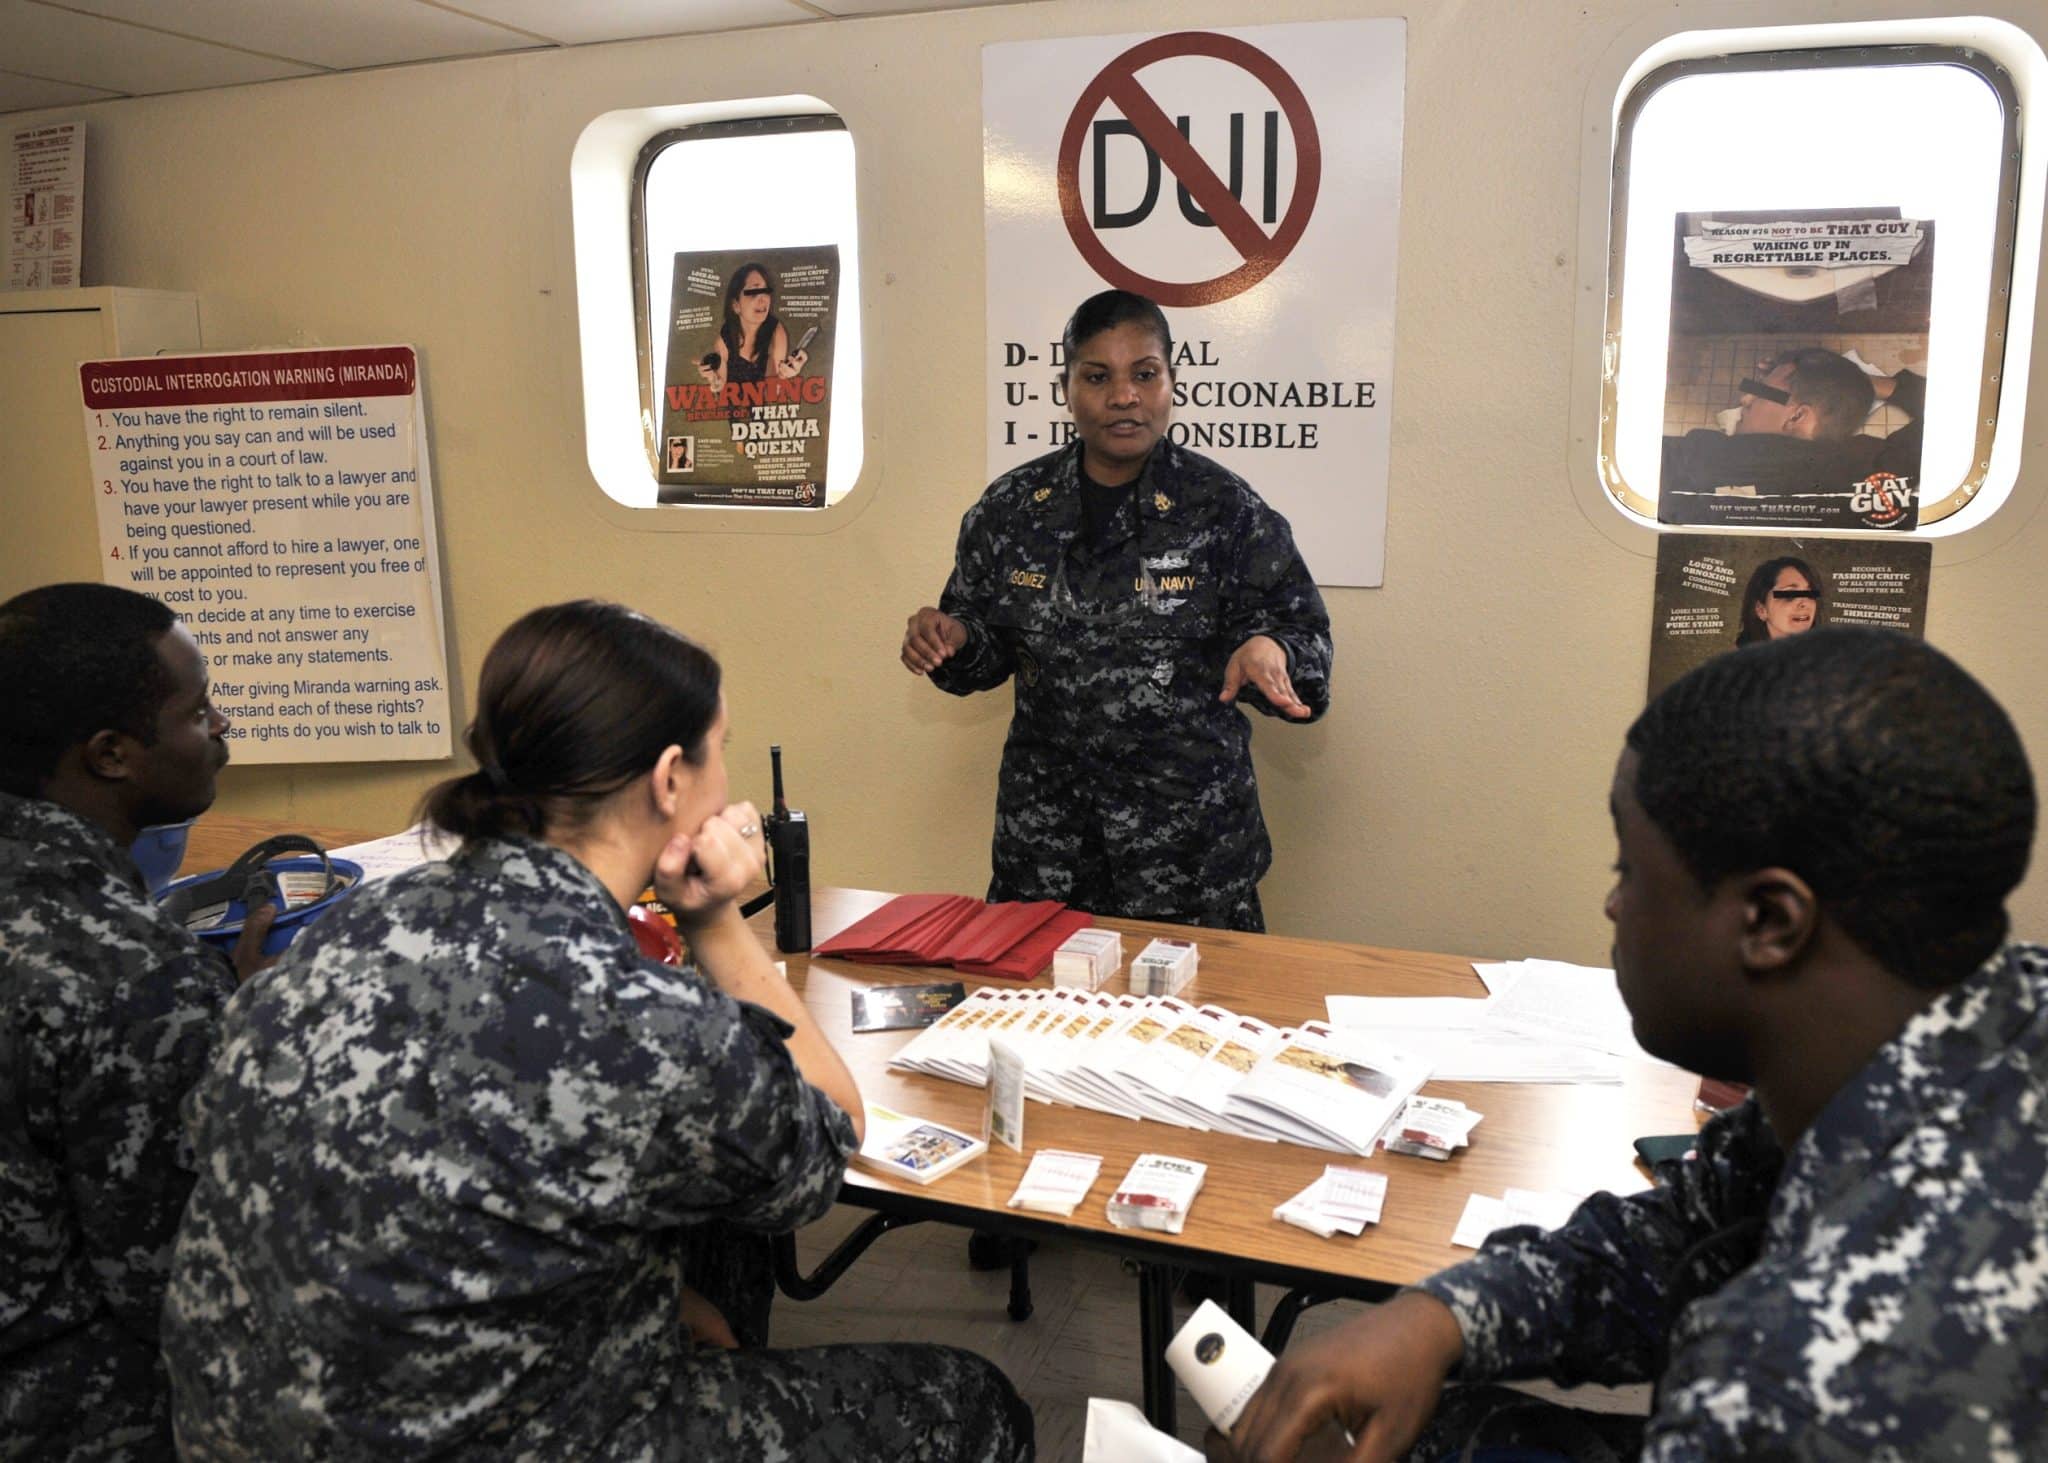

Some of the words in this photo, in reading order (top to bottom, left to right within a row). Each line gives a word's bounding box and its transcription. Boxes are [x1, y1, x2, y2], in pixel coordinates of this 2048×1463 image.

[1093, 110, 1279, 229] DUI
[1711, 228, 1750, 236] REASON
[1771, 227, 1792, 235] NOT
[1826, 225, 1872, 235] THAT
[1875, 222, 1909, 234] GUY
[1752, 241, 1809, 250] WAKING
[1813, 241, 1831, 250] UP
[1835, 240, 1851, 249] IN
[1713, 252, 1824, 263] REGRETTABLE
[1828, 250, 1891, 261] PLACES.
[91, 376, 163, 394] CUSTODIAL
[166, 370, 271, 391] INTERROGATION
[273, 367, 335, 385] WARNING
[339, 363, 408, 386] (MIRANDA)
[666, 376, 825, 411] WARNING
[1050, 381, 1376, 408] USCIONABLE
[96, 414, 109, 428] 1.
[112, 412, 141, 427] You
[145, 411, 181, 426] have
[185, 409, 209, 423] the
[213, 408, 246, 425] right
[250, 407, 264, 421] to
[268, 404, 320, 420] remain
[324, 402, 367, 418] silent.
[752, 404, 800, 420] THAT
[97, 435, 112, 450] 2.
[115, 434, 179, 452] Anything
[183, 434, 210, 450] you
[215, 433, 240, 448] say
[245, 431, 272, 444] can
[276, 428, 304, 441] and
[308, 426, 332, 440] will
[336, 425, 355, 439] be
[360, 423, 396, 438] used
[731, 419, 820, 441] DRAMA
[1049, 421, 1318, 449] IRONSIBLE
[744, 440, 805, 459] QUEEN
[120, 455, 173, 475] against
[177, 456, 204, 472] you
[208, 453, 221, 468] in
[225, 455, 235, 467] a
[239, 451, 277, 467] court
[280, 450, 295, 465] of
[299, 449, 328, 464] law.
[103, 479, 117, 495] 3.
[120, 479, 149, 494] You
[153, 478, 189, 492] have
[193, 477, 216, 490] the
[221, 474, 254, 493] right
[258, 475, 271, 488] to
[276, 472, 302, 487] talk
[306, 472, 320, 486] to
[325, 474, 334, 486] a
[338, 470, 387, 487] lawyer
[391, 469, 416, 483] and
[1852, 476, 1910, 495] THAT
[124, 501, 160, 515] have
[163, 501, 196, 517] your
[200, 499, 248, 515] lawyer
[252, 496, 308, 514] present
[311, 493, 350, 508] while
[354, 494, 381, 510] you
[385, 494, 410, 506] are
[1850, 488, 1912, 513] GUY
[126, 523, 167, 540] being
[171, 519, 255, 539] questioned.
[110, 546, 125, 560] 4.
[129, 545, 138, 560] If
[142, 547, 169, 563] you
[173, 544, 223, 558] cannot
[227, 540, 269, 556] afford
[273, 541, 287, 554] to
[291, 539, 319, 553] hire
[323, 541, 333, 553] a
[337, 537, 389, 555] lawyer,
[393, 538, 420, 550] one
[131, 567, 154, 581] will
[158, 566, 177, 580] be
[181, 563, 253, 582] appointed
[257, 563, 271, 577] to
[276, 560, 346, 579] represent
[350, 561, 376, 577] you
[380, 558, 410, 573] free
[1682, 566, 1736, 584] OBNOXIOUS
[1688, 560, 1714, 570] LOUD
[1713, 566, 1734, 576] AND
[1011, 570, 1047, 589] GOMEZ
[1160, 576, 1196, 591] NAVY
[164, 588, 195, 602] cost
[199, 588, 212, 601] to
[216, 588, 247, 604] you.
[176, 612, 193, 623] an
[197, 608, 246, 623] decide
[250, 608, 264, 621] at
[268, 608, 295, 624] any
[299, 605, 331, 620] time
[335, 605, 349, 618] to
[353, 602, 416, 619] exercise
[1843, 609, 1900, 620] SHRIEKING
[226, 629, 253, 644] and
[258, 629, 281, 643] not
[285, 629, 338, 642] answer
[343, 628, 369, 643] any
[213, 655, 228, 666] or
[232, 651, 272, 665] make
[277, 652, 303, 667] any
[308, 648, 393, 664] statements.
[211, 682, 244, 697] After
[248, 681, 289, 699] giving
[294, 679, 351, 695] Miranda
[354, 678, 410, 695] warning
[415, 677, 443, 691] ask.
[278, 702, 313, 716] each
[316, 700, 331, 715] of
[334, 701, 373, 714] these
[377, 698, 425, 717] rights?
[222, 727, 247, 739] ese
[251, 724, 289, 741] rights
[293, 724, 311, 737] do
[315, 725, 340, 740] you
[344, 722, 376, 736] wish
[380, 722, 394, 735] to
[398, 720, 423, 734] talk
[427, 720, 440, 734] to
